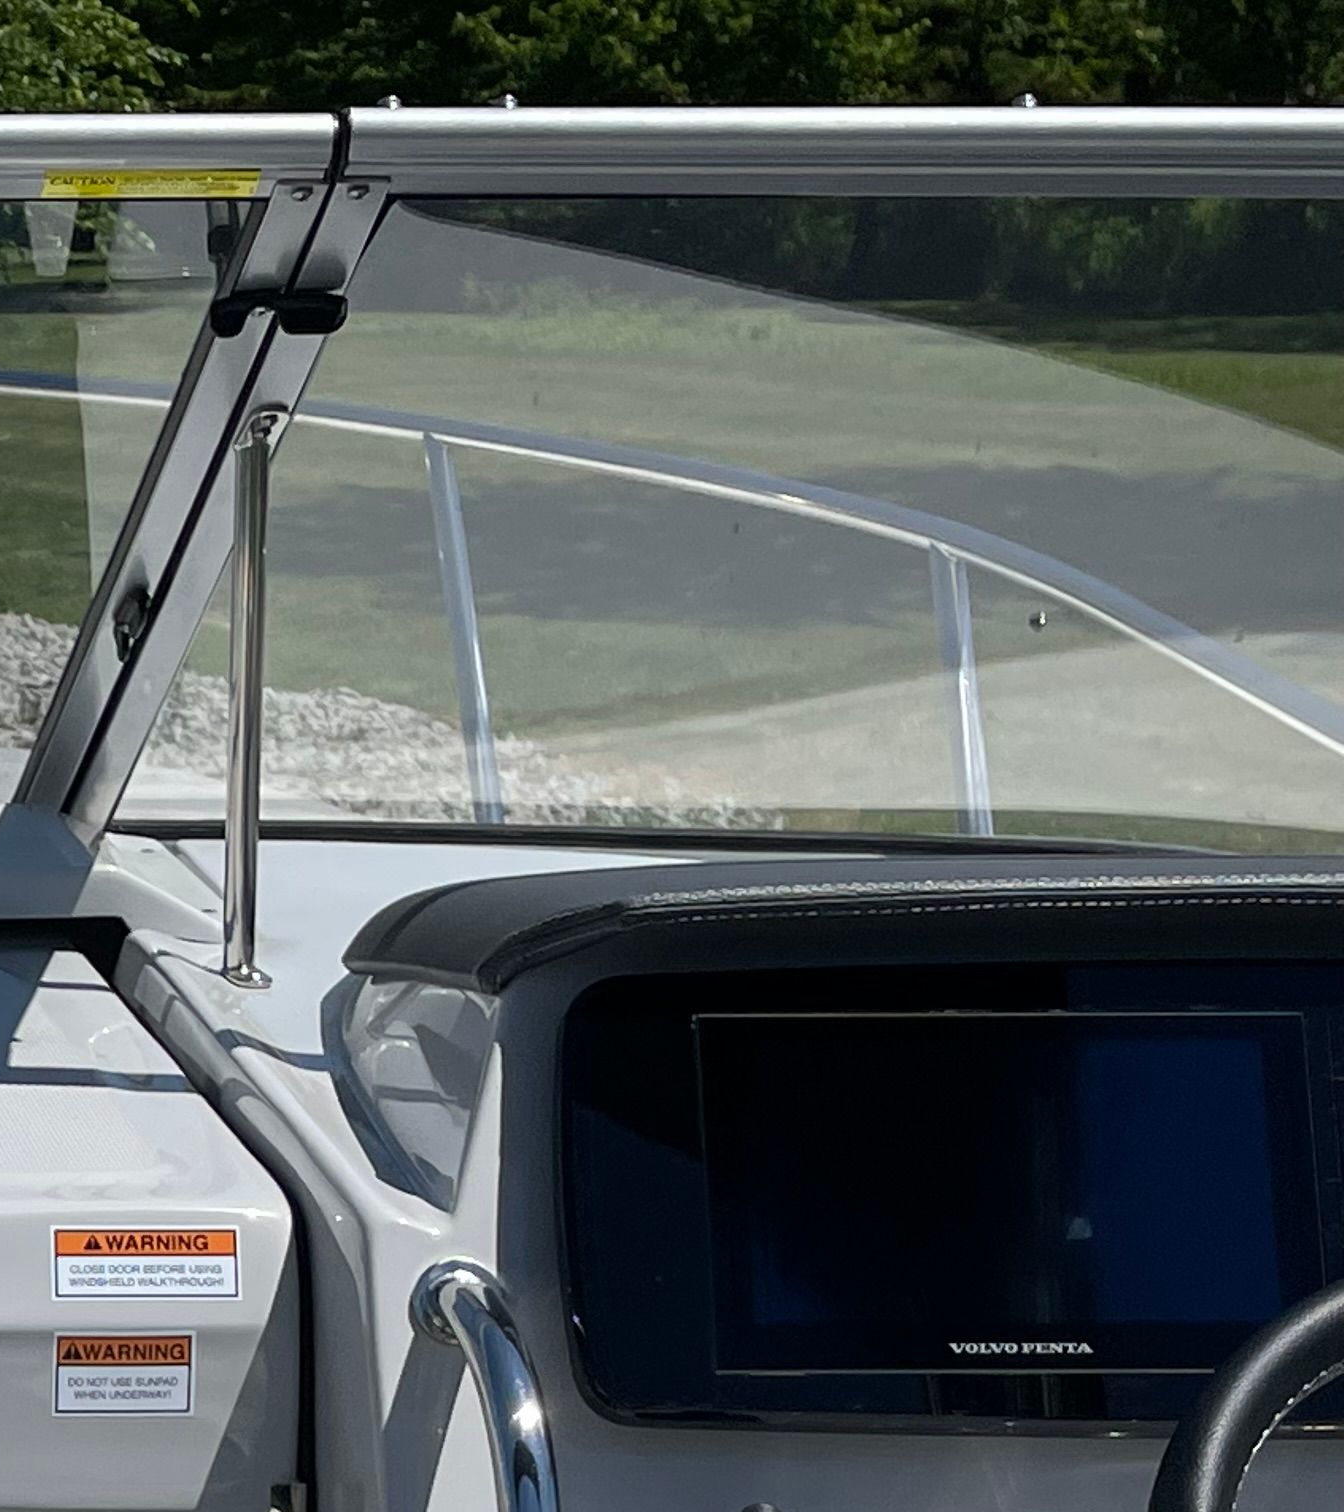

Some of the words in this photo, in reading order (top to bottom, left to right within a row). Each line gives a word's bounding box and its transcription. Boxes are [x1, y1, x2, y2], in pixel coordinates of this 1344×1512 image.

[49, 175, 116, 186] CAUTION
[105, 1234, 209, 1251] WARNING
[69, 1264, 105, 1274] CLOSE
[108, 1264, 141, 1274] DOOR
[143, 1264, 186, 1274] BEFORE
[189, 1264, 223, 1274] USING
[69, 1277, 135, 1287] WINDSHIELD
[82, 1343, 185, 1361] WARNING
[948, 1342, 1018, 1354] VOLVO
[1020, 1342, 1095, 1354] PENTA
[67, 1377, 84, 1387] DO
[87, 1377, 108, 1387] NOT
[110, 1377, 132, 1387] USE
[135, 1377, 178, 1387] SUNPAD
[73, 1390, 106, 1400] WHEN
